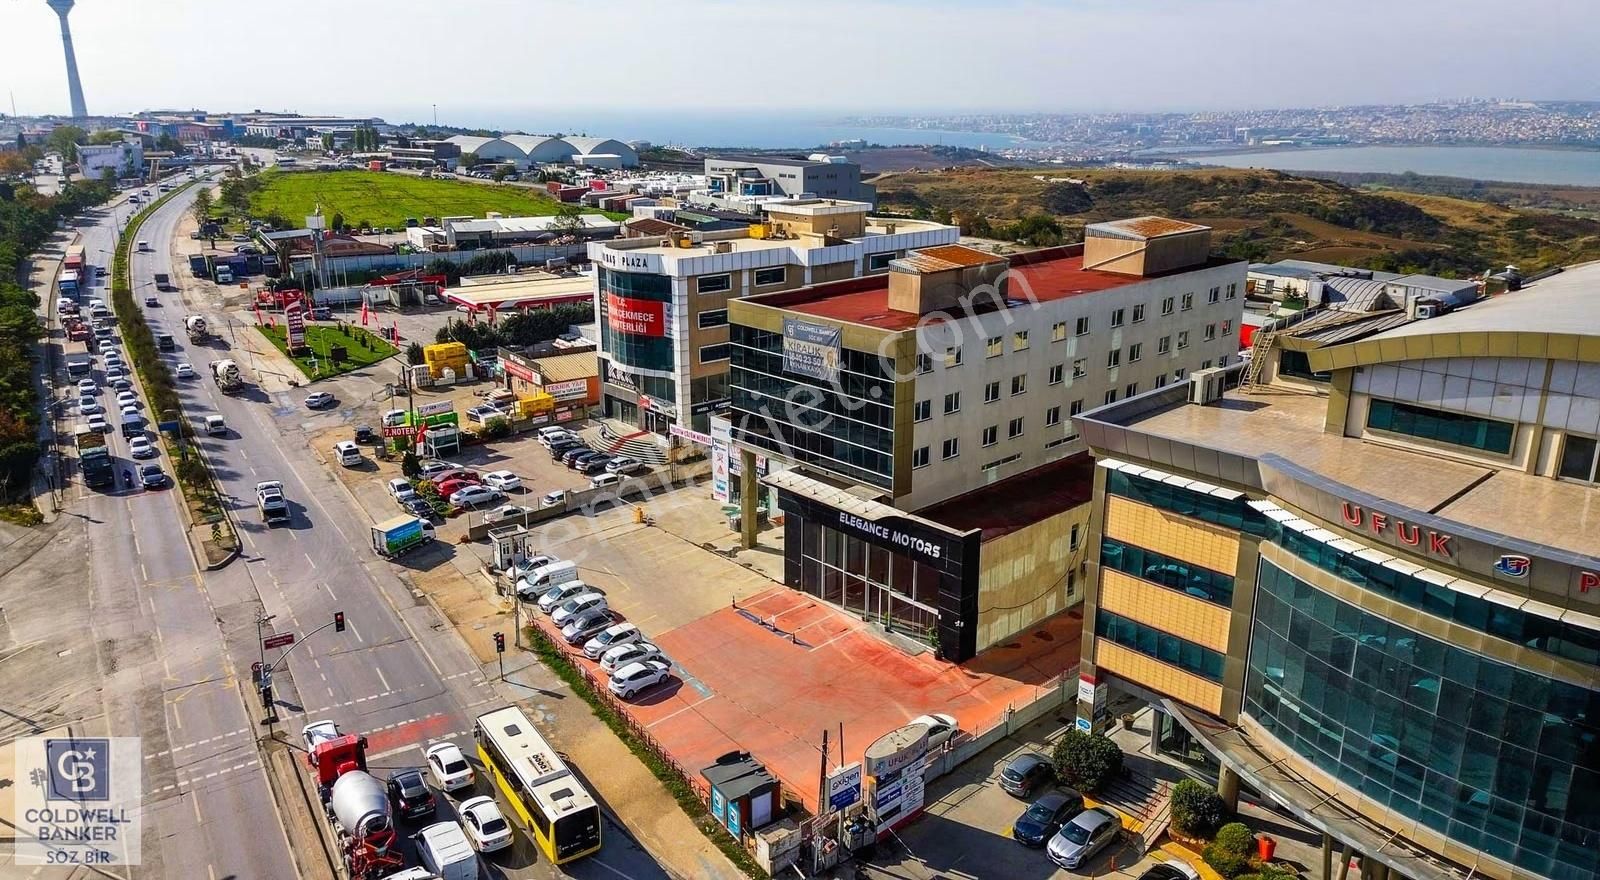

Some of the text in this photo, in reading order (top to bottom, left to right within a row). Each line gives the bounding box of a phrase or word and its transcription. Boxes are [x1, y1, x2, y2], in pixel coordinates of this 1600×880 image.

[622, 257, 648, 268] PLAZA
[839, 512, 941, 558] ELEGANCE MOTORS
[1343, 502, 1452, 557] UFUK
